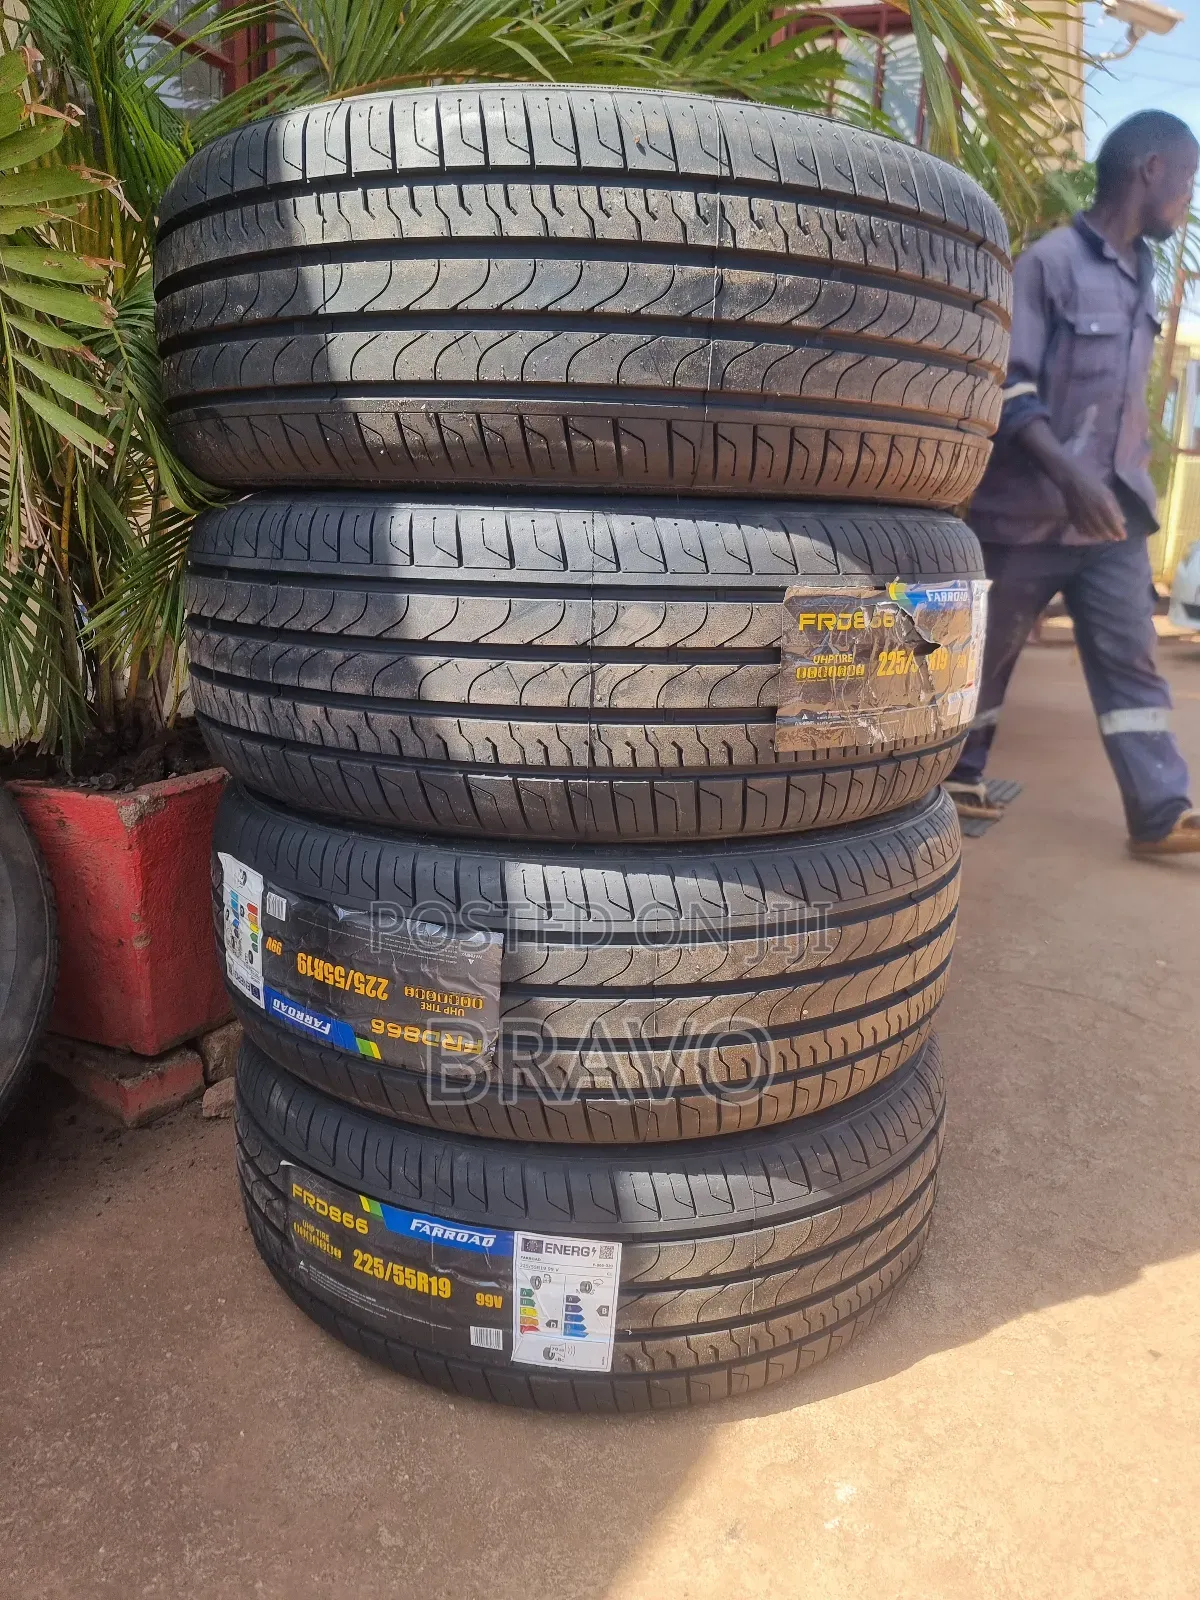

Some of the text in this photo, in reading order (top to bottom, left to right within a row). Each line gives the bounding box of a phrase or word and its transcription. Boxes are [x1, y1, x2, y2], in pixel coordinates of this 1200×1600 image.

[926, 589, 970, 602] FARROAD
[813, 653, 853, 664] UHP TIRE
[265, 936, 283, 956] 99V
[297, 952, 389, 1001] 225/55R19
[272, 998, 332, 1035] FARROAD
[420, 1001, 465, 1017] UHP TIRE
[371, 1018, 483, 1055] FRD866
[292, 1183, 369, 1235] FRD866
[302, 1219, 330, 1243] UHP TIRE
[410, 1218, 497, 1248] FARROAD
[544, 1242, 591, 1257] ENERG
[353, 1248, 452, 1299] 225/55R19
[475, 1292, 503, 1309] 99V
